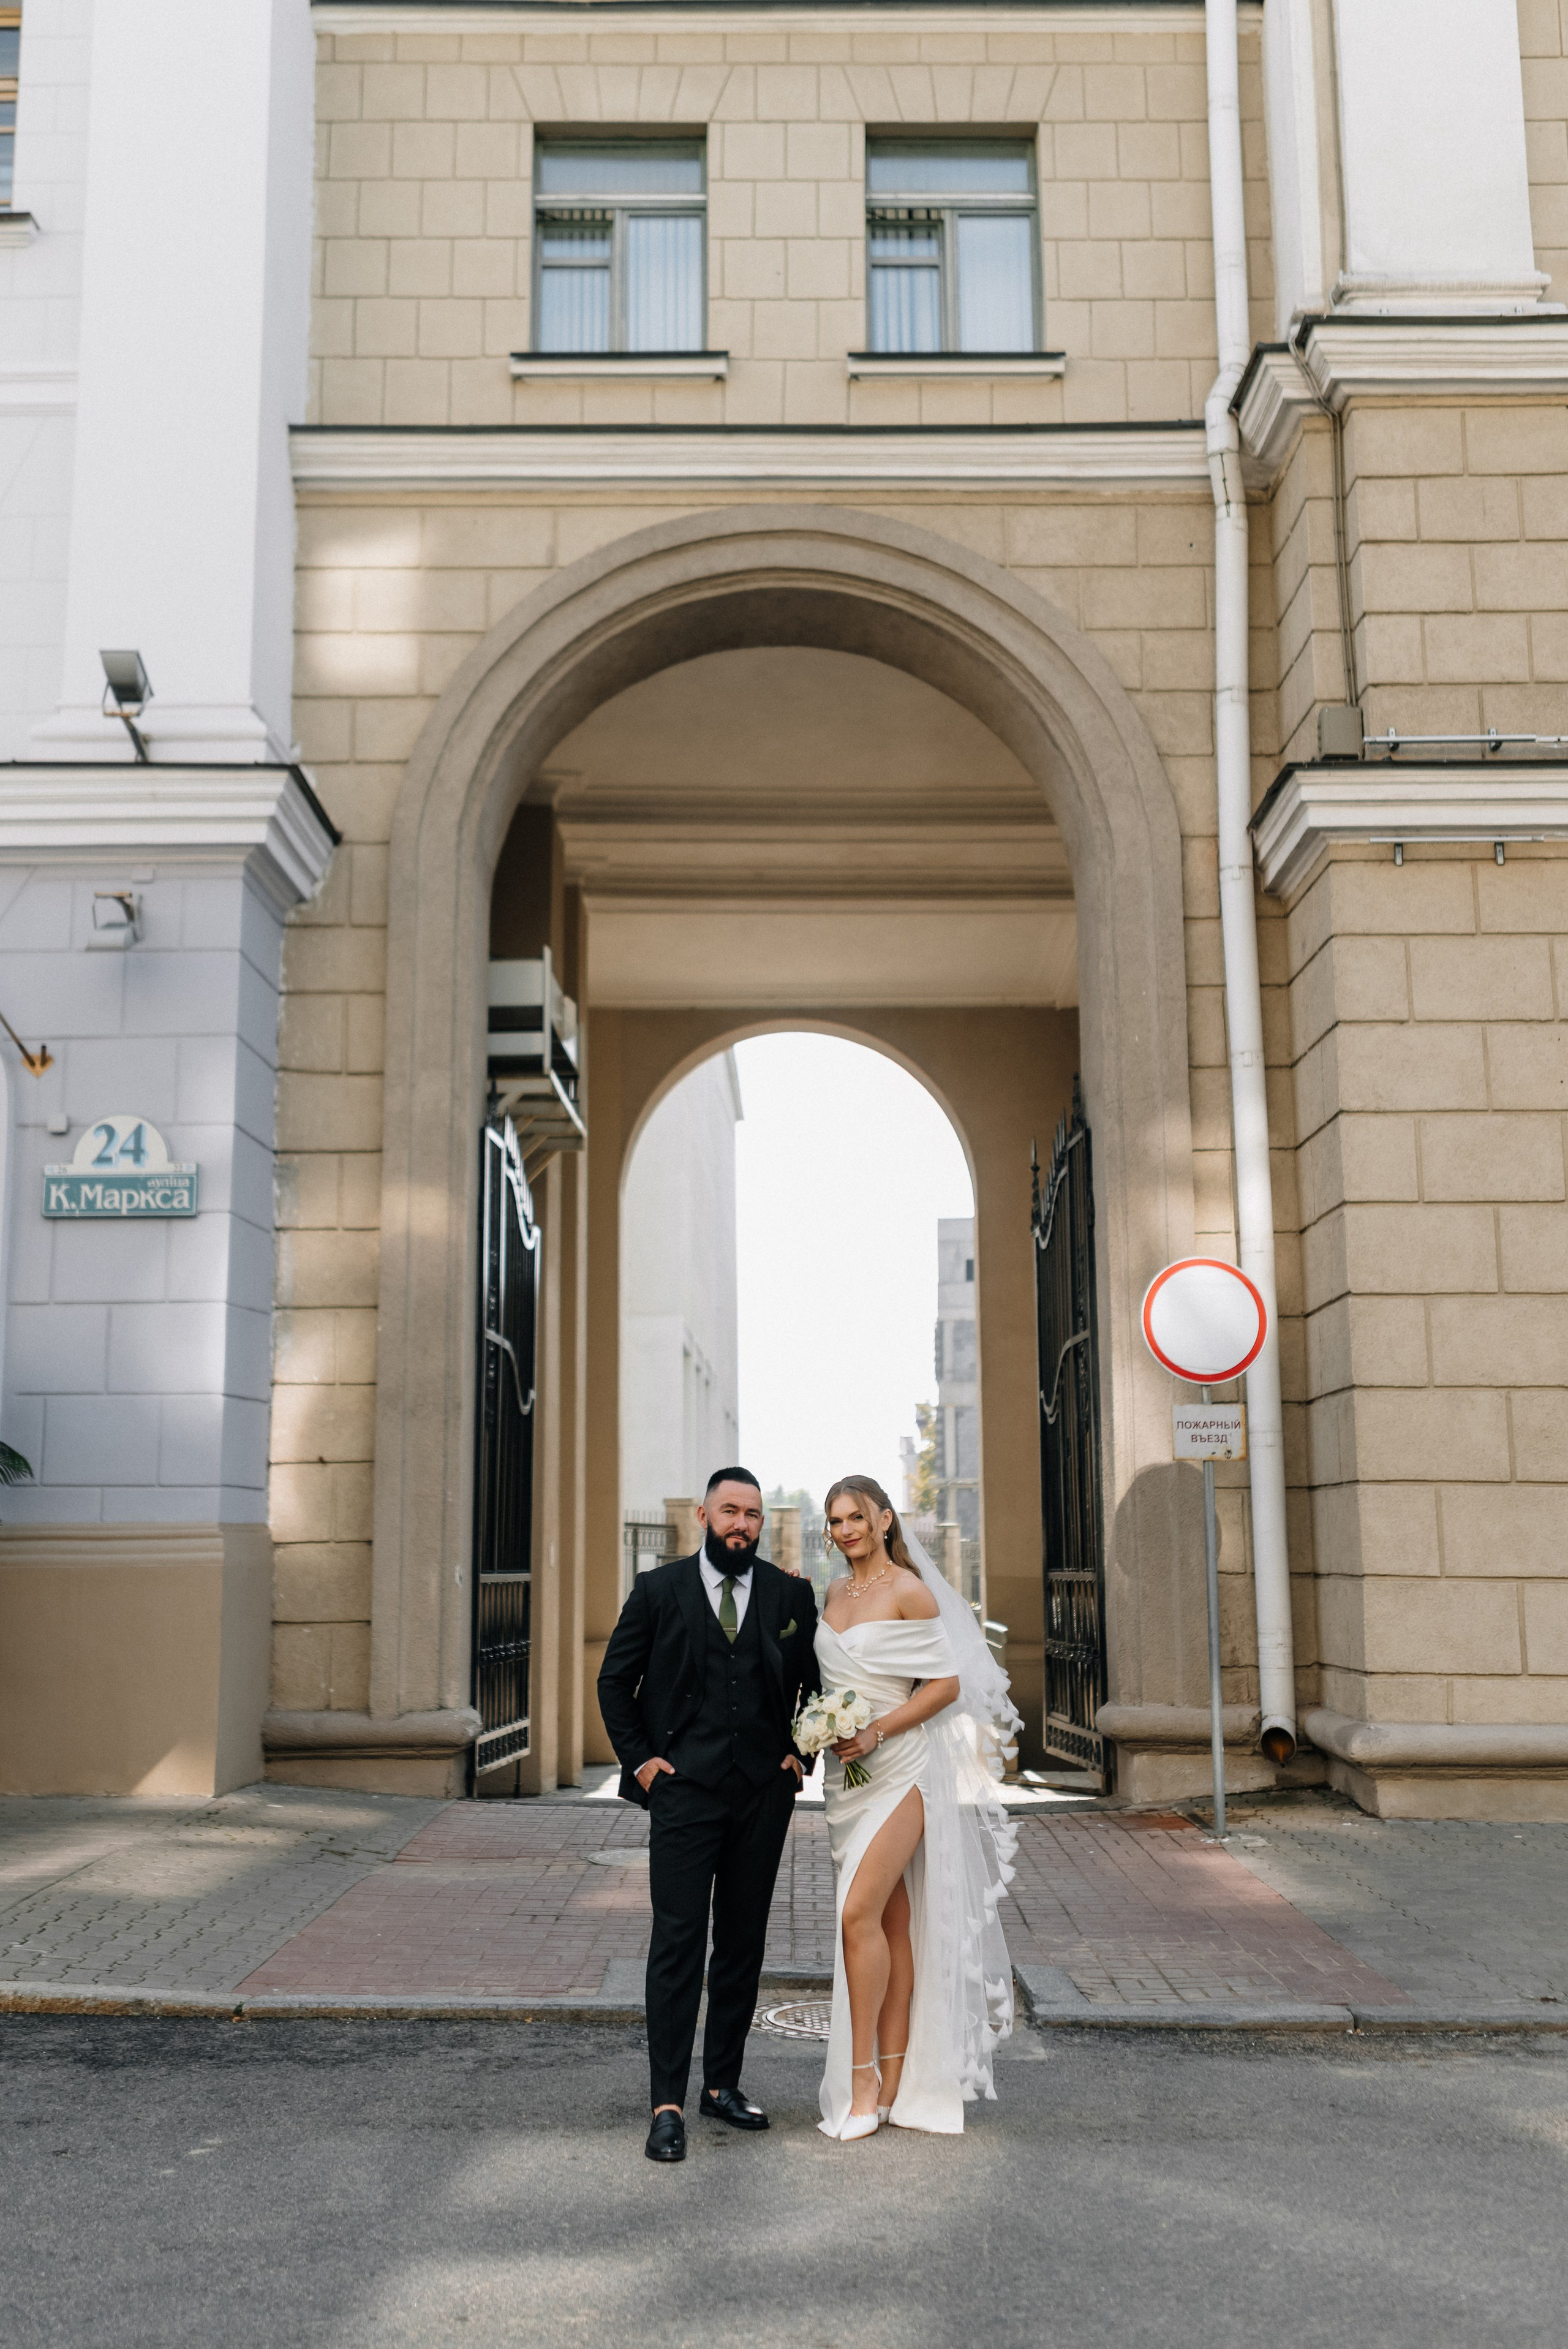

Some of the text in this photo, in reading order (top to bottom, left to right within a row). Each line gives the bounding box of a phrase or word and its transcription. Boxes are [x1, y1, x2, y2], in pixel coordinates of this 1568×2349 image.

[92, 1122, 146, 1165] 24
[1177, 1419, 1241, 1429] ПОЖАРНЫЙ
[1191, 1434, 1228, 1443] ВЪЕЗД
